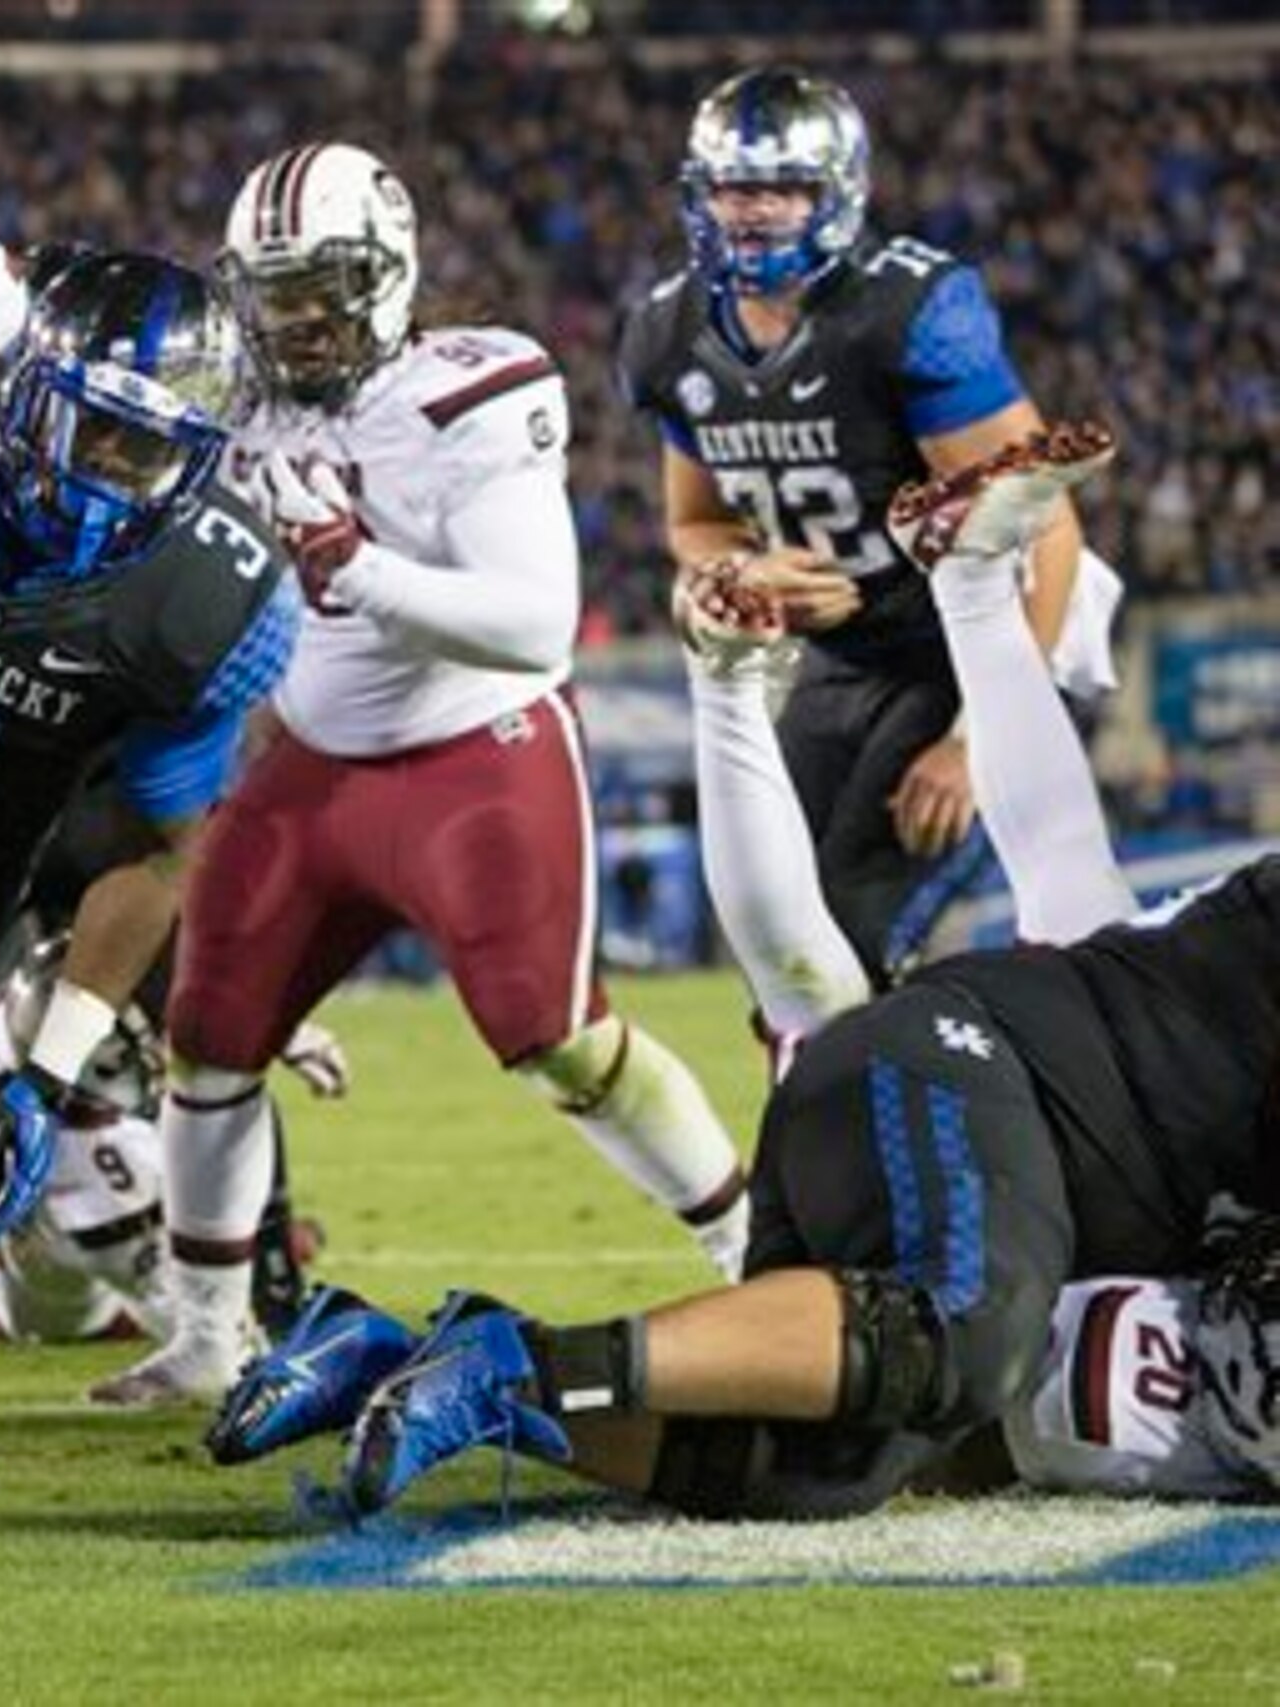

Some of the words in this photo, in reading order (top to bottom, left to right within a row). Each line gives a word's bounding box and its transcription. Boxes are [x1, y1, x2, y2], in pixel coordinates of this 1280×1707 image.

[194, 506, 267, 578] 3
[714, 465, 896, 576] 72
[1134, 1320, 1194, 1410] 20
